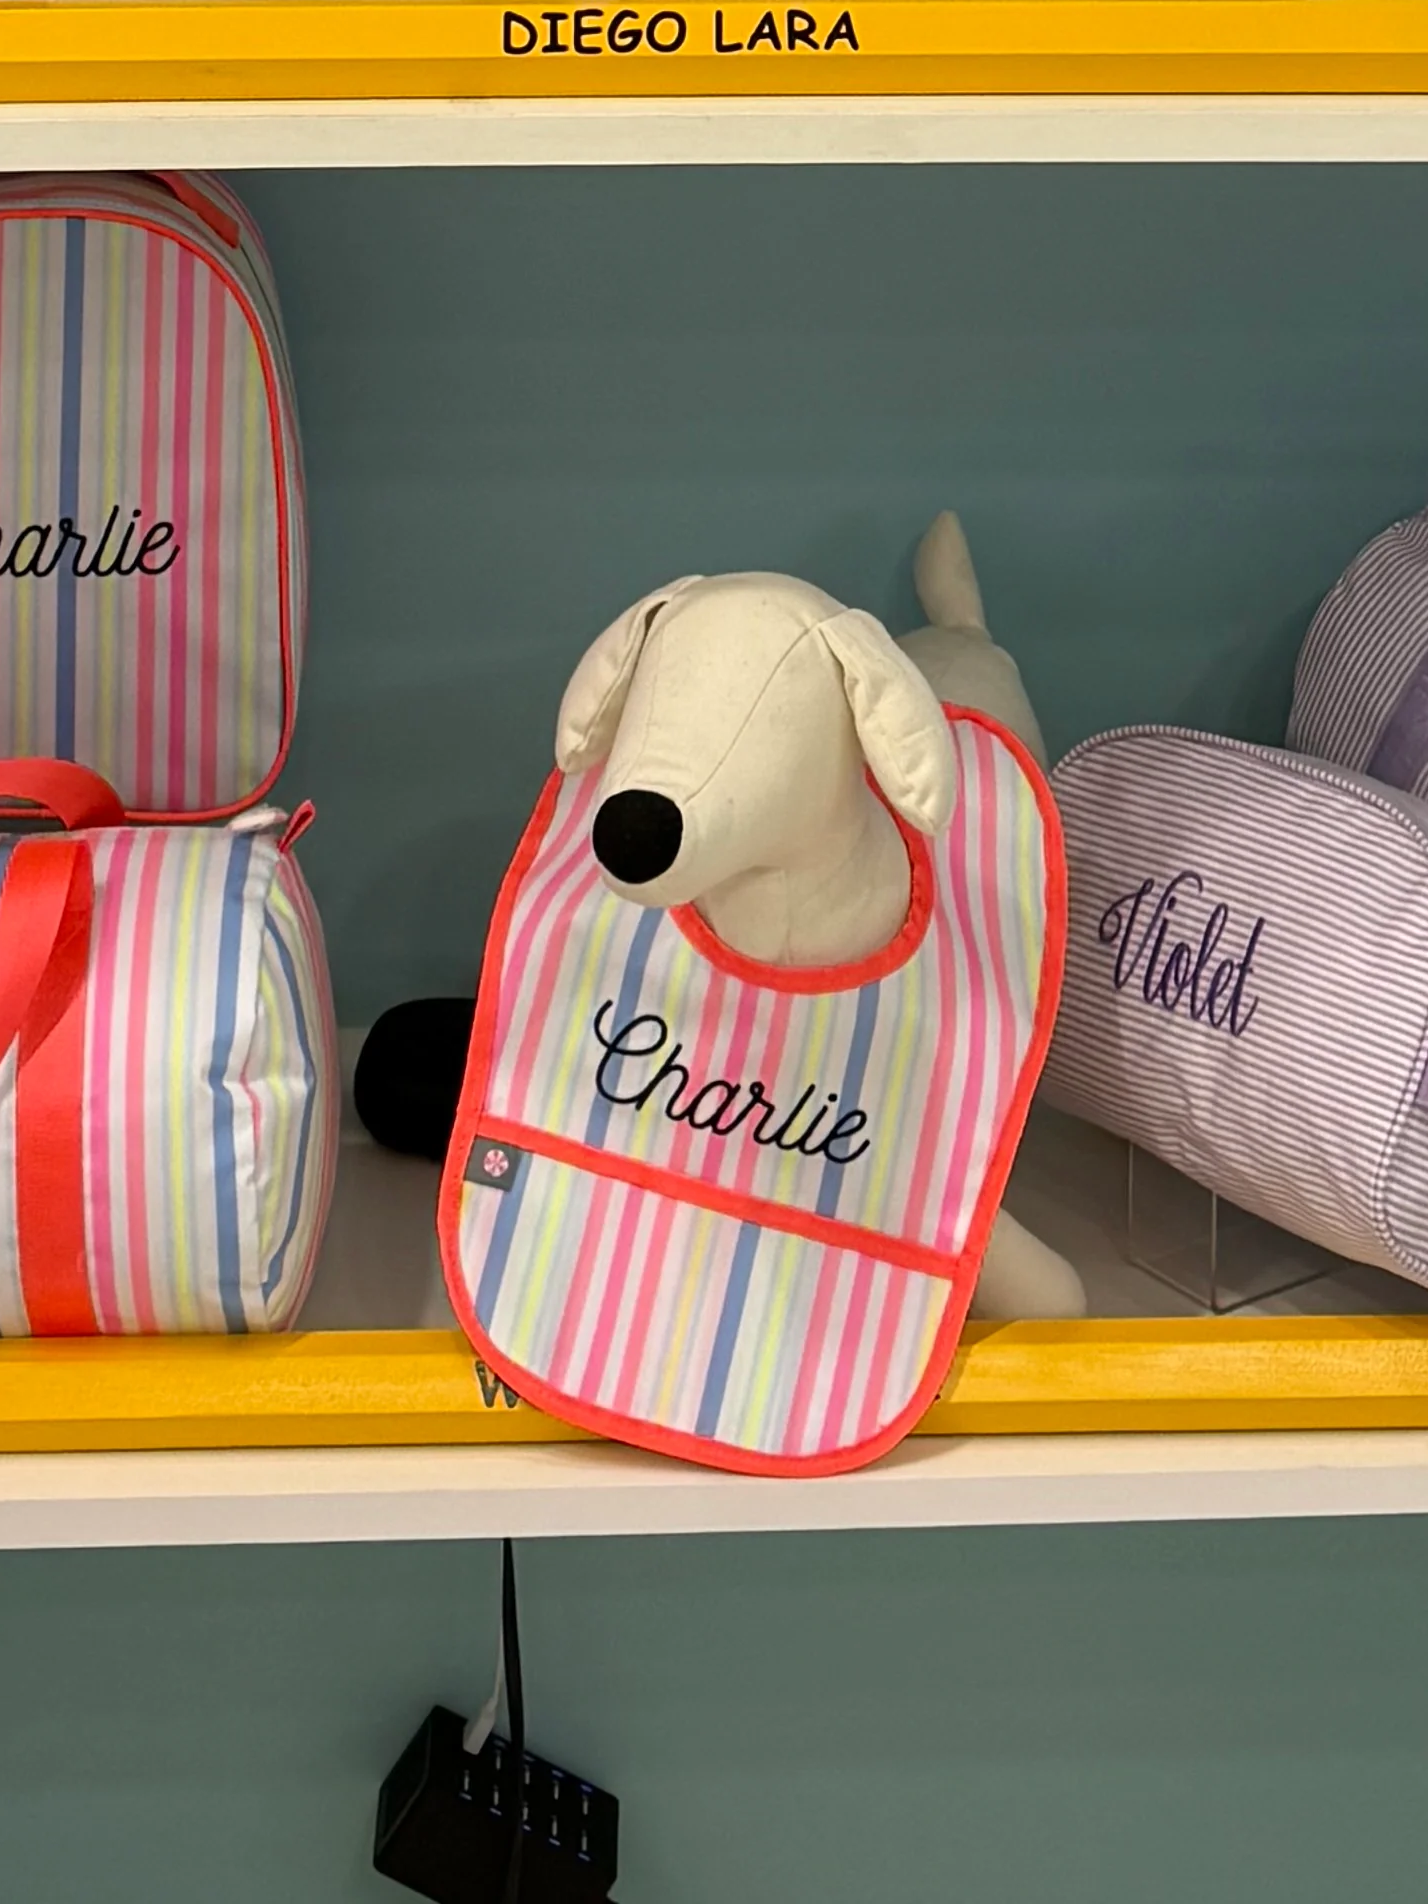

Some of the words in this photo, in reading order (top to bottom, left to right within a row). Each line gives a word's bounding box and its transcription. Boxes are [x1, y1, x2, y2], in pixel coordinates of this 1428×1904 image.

[503, 8, 687, 56] DIEGO
[714, 10, 860, 55] LARA
[1098, 868, 1266, 1039] Violet
[593, 999, 870, 1166] Charlie
